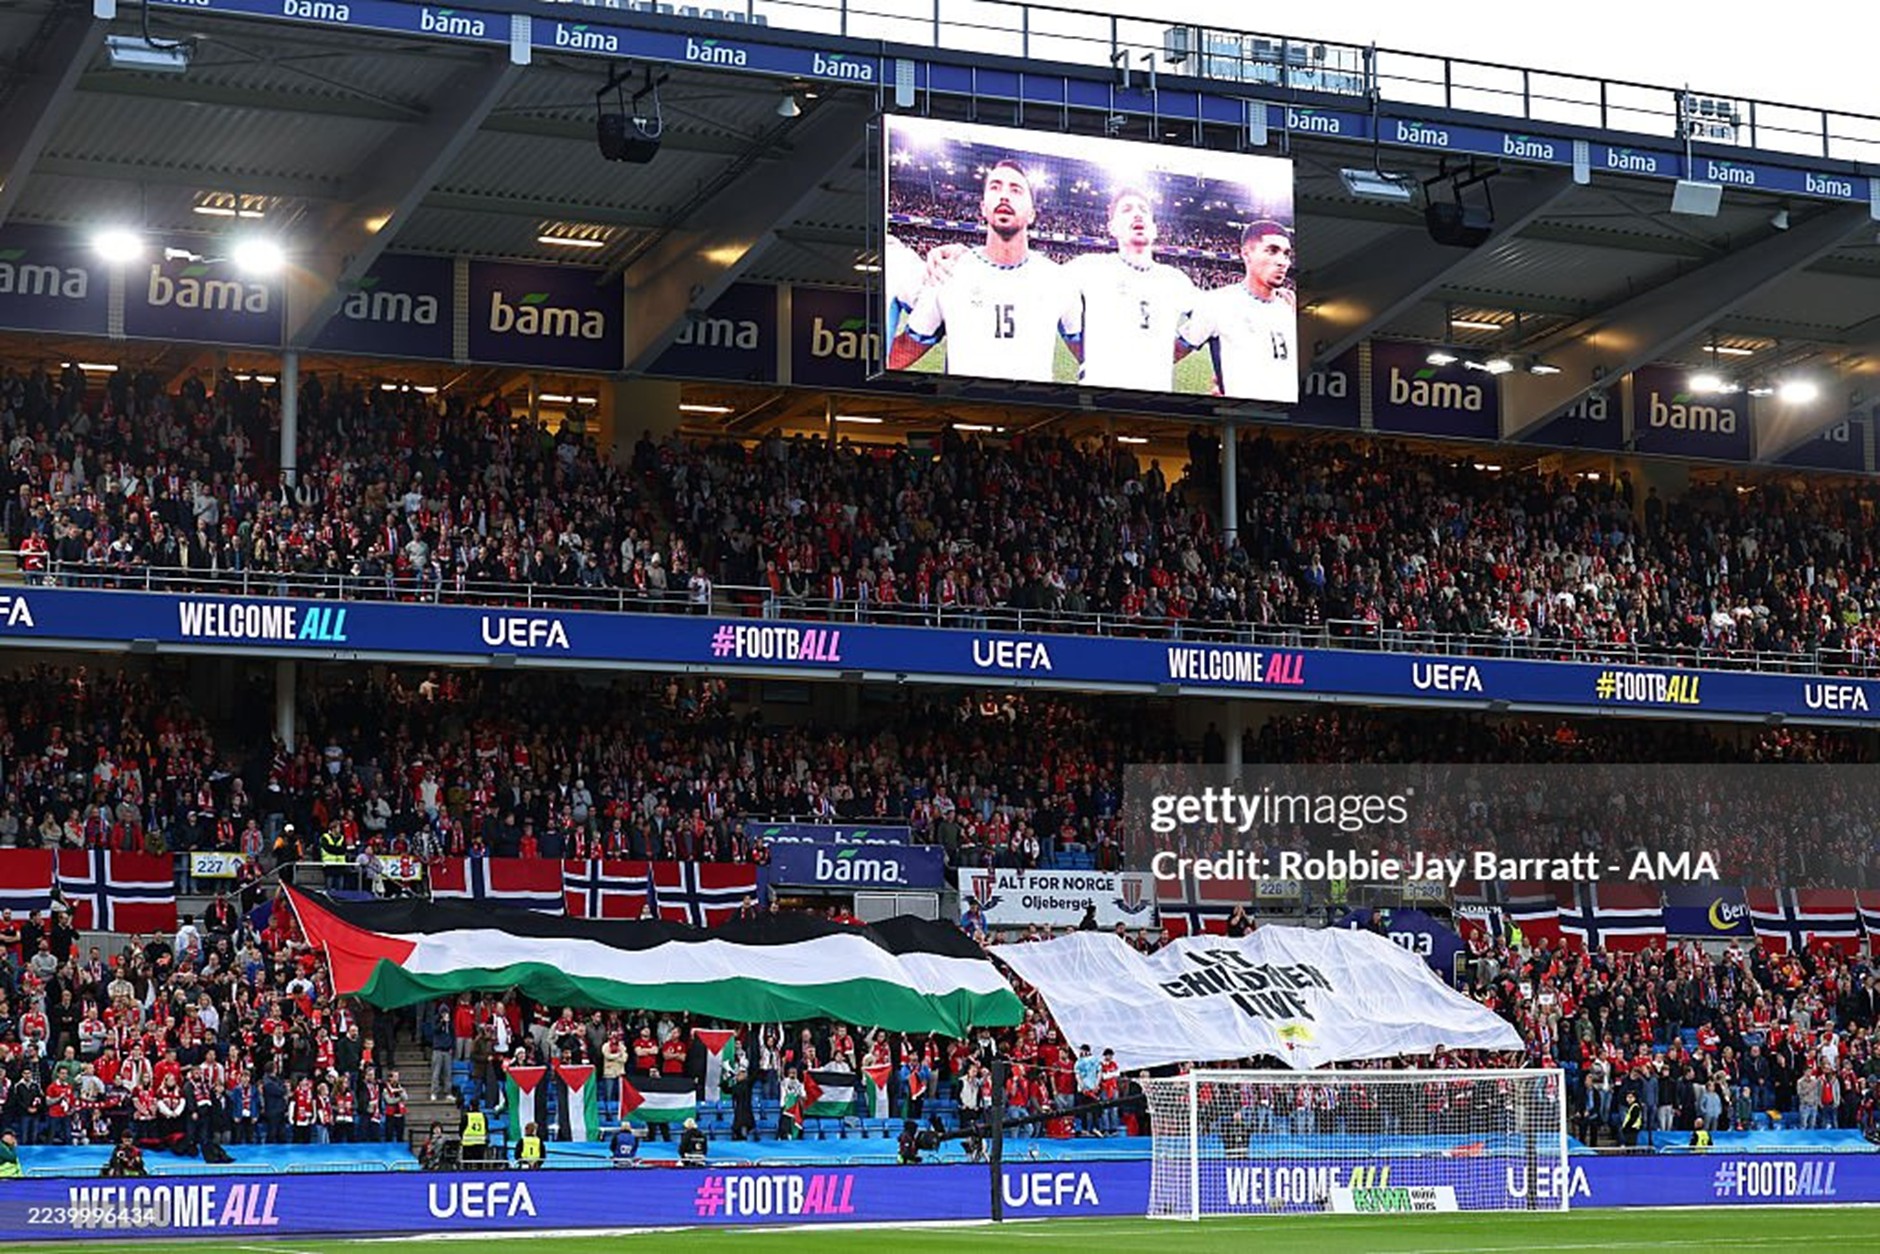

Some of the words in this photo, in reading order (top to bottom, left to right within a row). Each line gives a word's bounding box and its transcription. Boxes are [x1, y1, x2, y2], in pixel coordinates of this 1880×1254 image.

[420, 9, 485, 37] bama
[555, 24, 618, 52] bama
[686, 39, 747, 66] bama
[813, 54, 873, 81] bama
[1288, 109, 1340, 134] bama
[1397, 121, 1448, 146] bama
[1504, 134, 1554, 159] bama
[1608, 148, 1657, 173] bama
[1708, 162, 1755, 184] bama
[1806, 173, 1851, 197] bama
[0, 264, 88, 298] ama
[148, 264, 269, 313] bama
[344, 291, 438, 325] ama
[489, 292, 605, 339] bama
[994, 304, 1015, 339] 15
[1270, 331, 1288, 360] 13
[1390, 368, 1482, 411] bama
[1650, 392, 1736, 434] bama
[179, 601, 296, 639] WELCOME
[298, 606, 347, 641] ALL
[482, 616, 569, 649] UEFA
[711, 625, 841, 662] #FOOTBALL
[973, 639, 1052, 670] UEFA
[1168, 648, 1263, 682] WELCOME
[1265, 653, 1304, 684] ALL
[1413, 662, 1483, 691] UEFA
[1596, 671, 1699, 704] #FOOTBALL
[1805, 684, 1869, 711] UEFA
[197, 860, 223, 874] 227
[816, 849, 899, 882] bama
[998, 876, 1026, 889] ALT
[1030, 876, 1059, 890] FOR
[1063, 877, 1114, 891] NORGE
[1022, 895, 1093, 911] Oljeberget
[694, 1174, 855, 1216] #FOOTBALL
[1002, 1172, 1099, 1206] UEFA
[1226, 1166, 1341, 1205] WELCOME
[1506, 1165, 1591, 1198] UEFA
[1713, 1160, 1837, 1197] #FOOTBALL
[69, 1185, 216, 1229] WELCOME
[219, 1184, 279, 1225] ALL
[429, 1182, 536, 1218] UEFA
